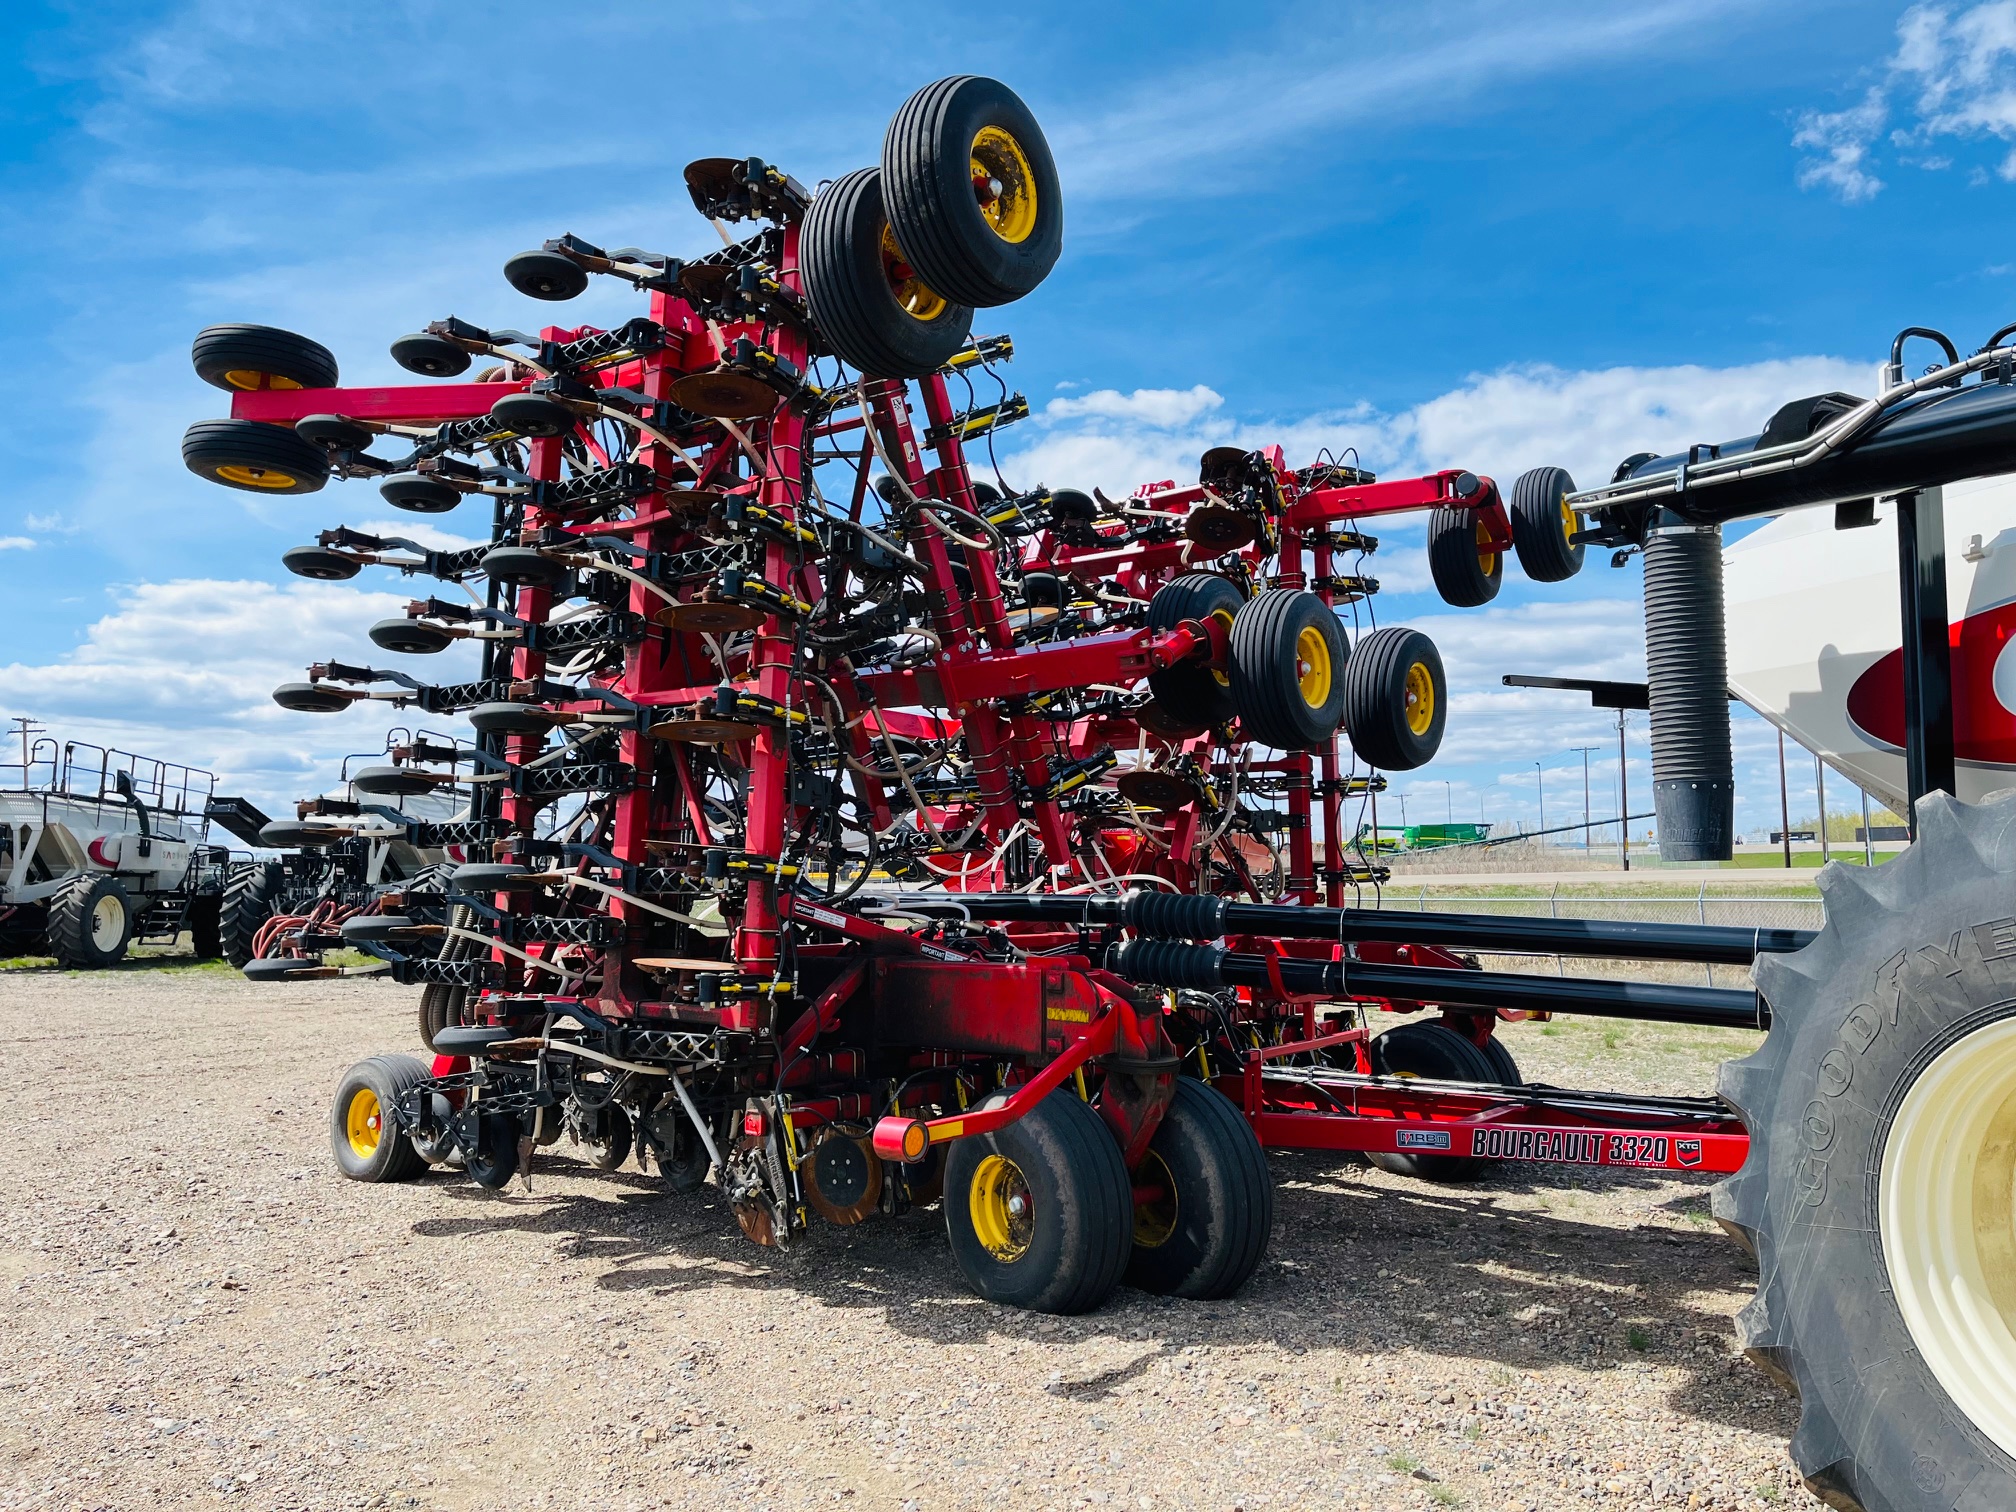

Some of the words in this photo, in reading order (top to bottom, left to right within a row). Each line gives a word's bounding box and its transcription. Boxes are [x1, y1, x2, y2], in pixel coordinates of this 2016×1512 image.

[921, 945, 945, 959] IMPORTANT
[1400, 1131, 1436, 1145] MRB
[1471, 1128, 1605, 1163] BOURGAULT
[1608, 1134, 1669, 1164] 3320
[1678, 1142, 1699, 1150] XTC
